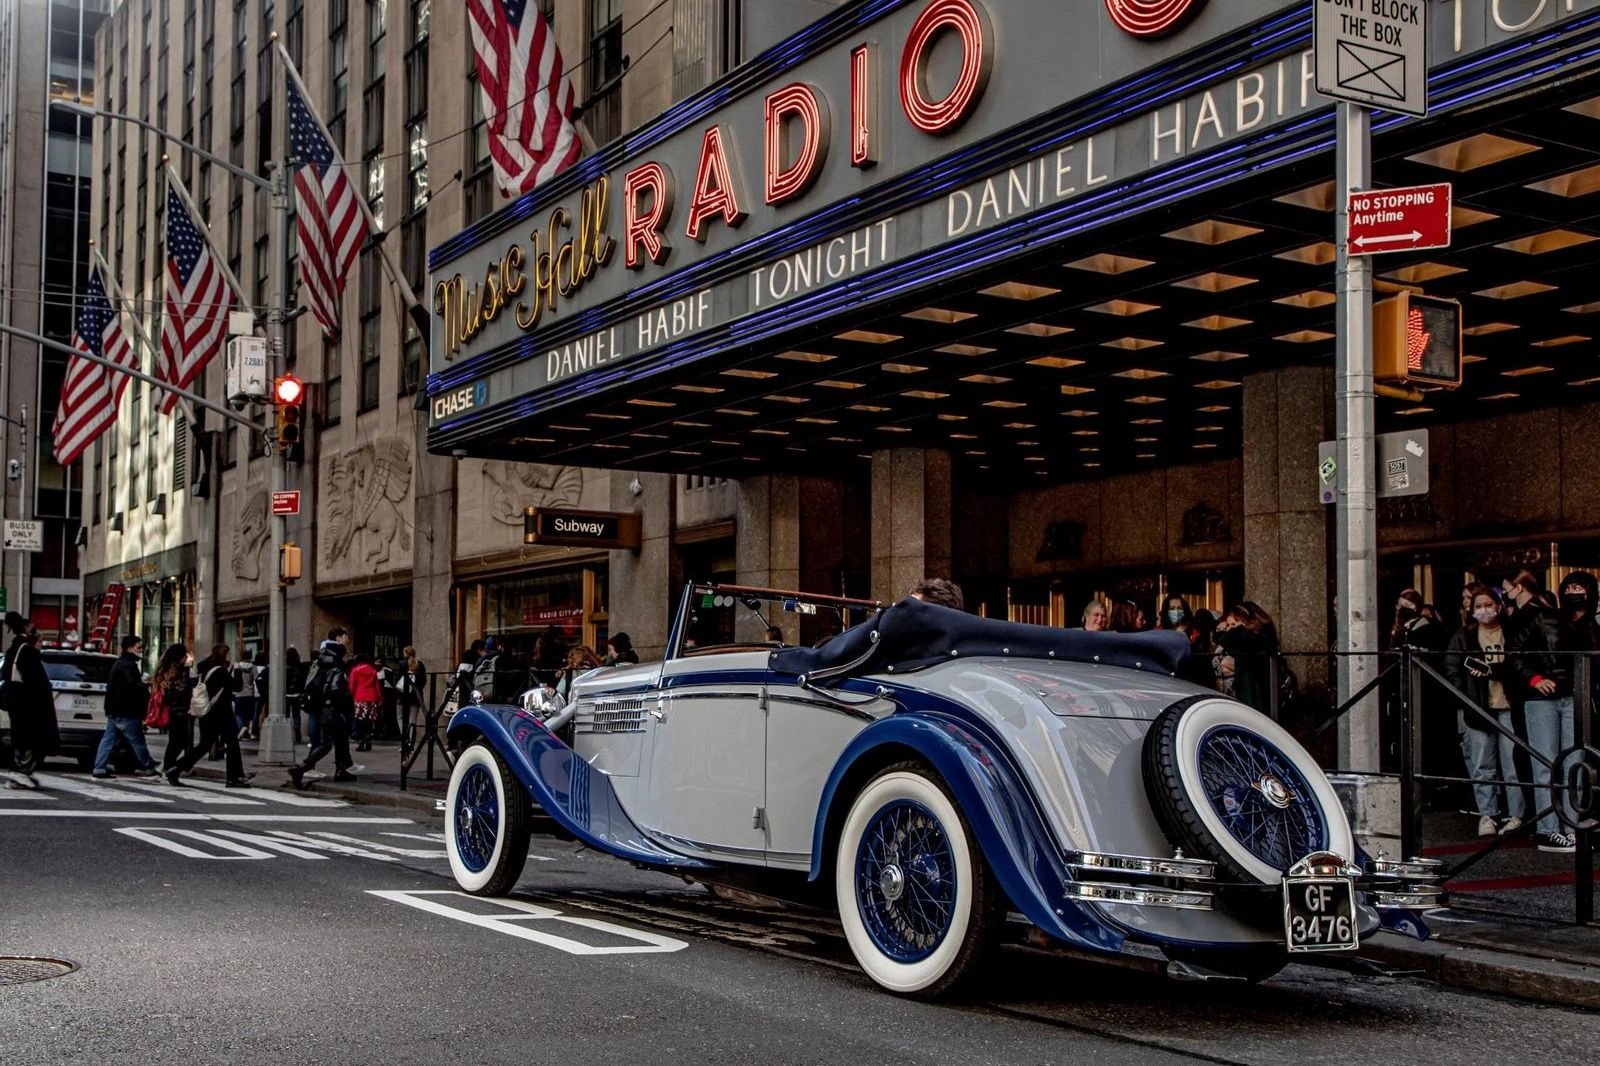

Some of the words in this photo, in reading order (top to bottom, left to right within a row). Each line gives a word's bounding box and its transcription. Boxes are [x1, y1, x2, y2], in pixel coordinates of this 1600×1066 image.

[1372, 0, 1418, 25] BLOCK
[1341, 14, 1368, 39] THE
[1374, 22, 1402, 47] BOX
[625, 0, 986, 269] RADIO
[1353, 199, 1371, 212] NO
[1373, 192, 1435, 210] STOPPING
[1353, 211, 1404, 226] Anytime
[516, 173, 616, 331] Hall
[546, 327, 621, 382] DANIEL
[638, 289, 711, 348] HABIF
[752, 218, 894, 306] TONIGHT
[948, 137, 1108, 237] DANIEL
[435, 386, 474, 420] CHASE
[9, 522, 36, 530] BUSES
[12, 530, 32, 538] ONLY
[554, 518, 605, 536] Subway
[1305, 885, 1334, 912] GF
[1292, 915, 1351, 943] 3476
